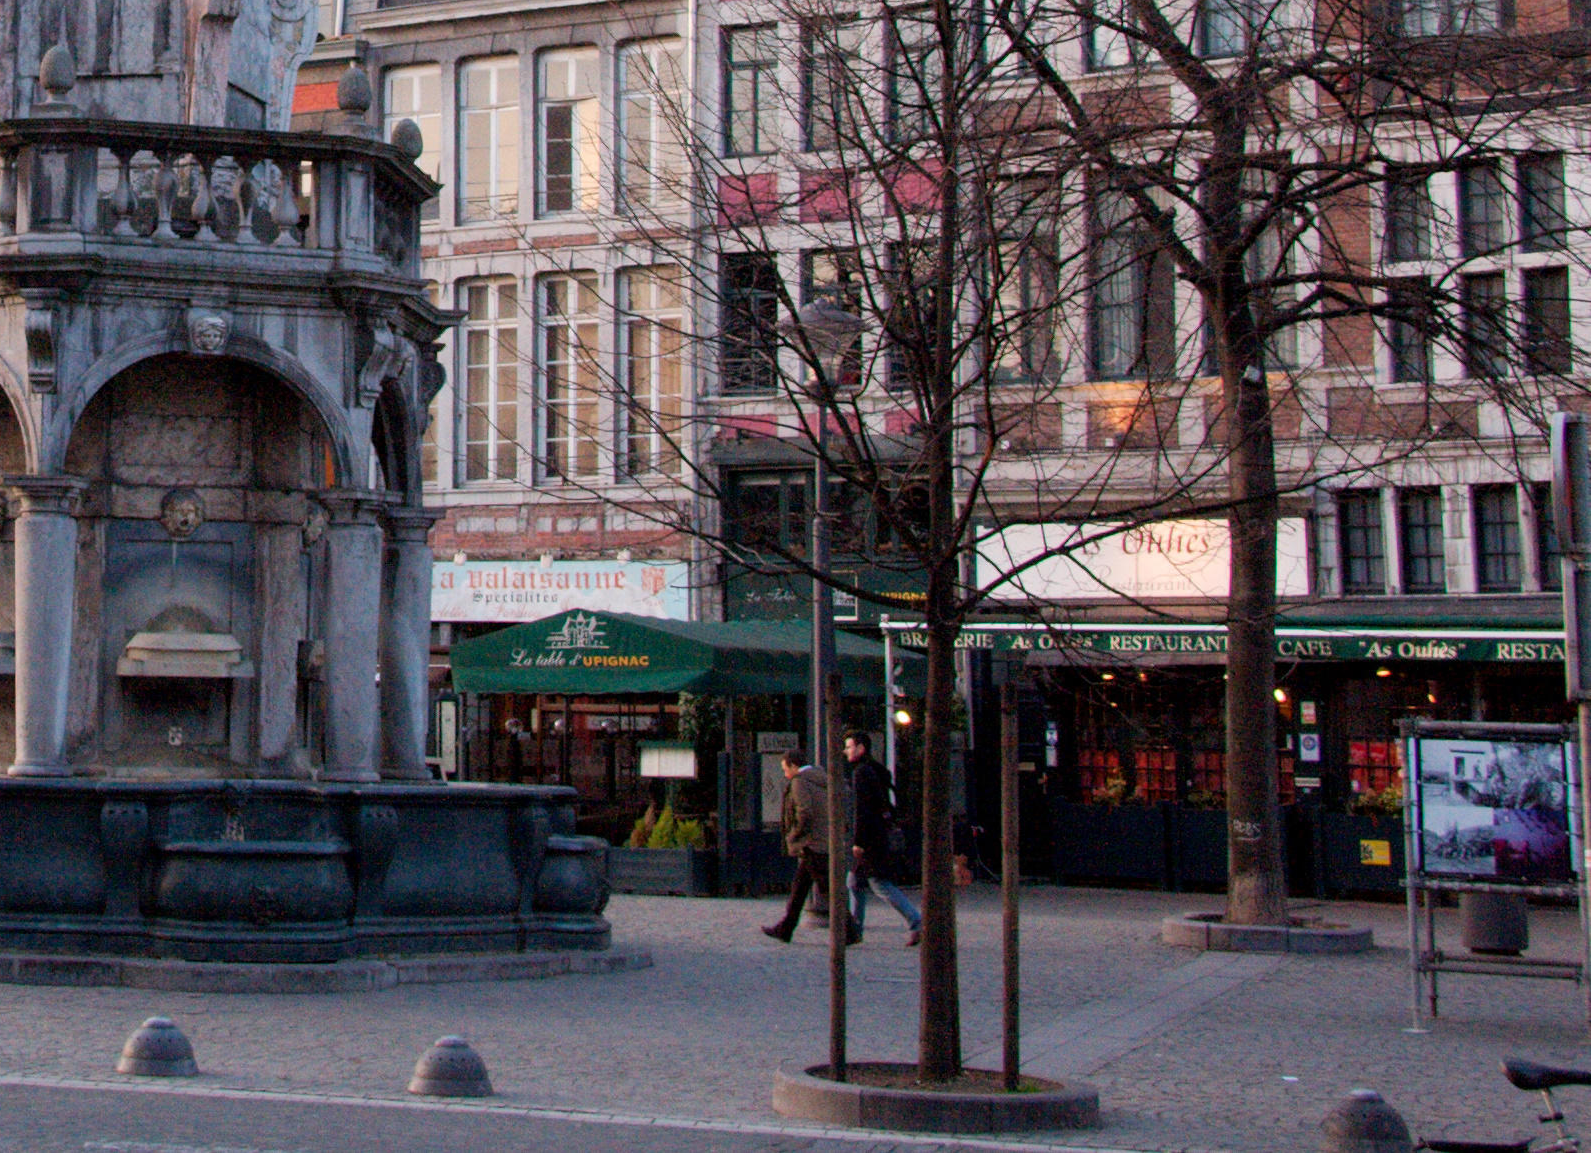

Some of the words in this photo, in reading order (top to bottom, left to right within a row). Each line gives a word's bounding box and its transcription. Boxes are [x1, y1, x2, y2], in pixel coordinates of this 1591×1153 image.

[432, 567, 454, 590] a
[510, 649, 533, 667] La
[535, 650, 566, 667] table
[900, 632, 995, 650] BRAERIE
[1109, 634, 1229, 652] RESTAURANT
[1495, 642, 1566, 661] RESTA
